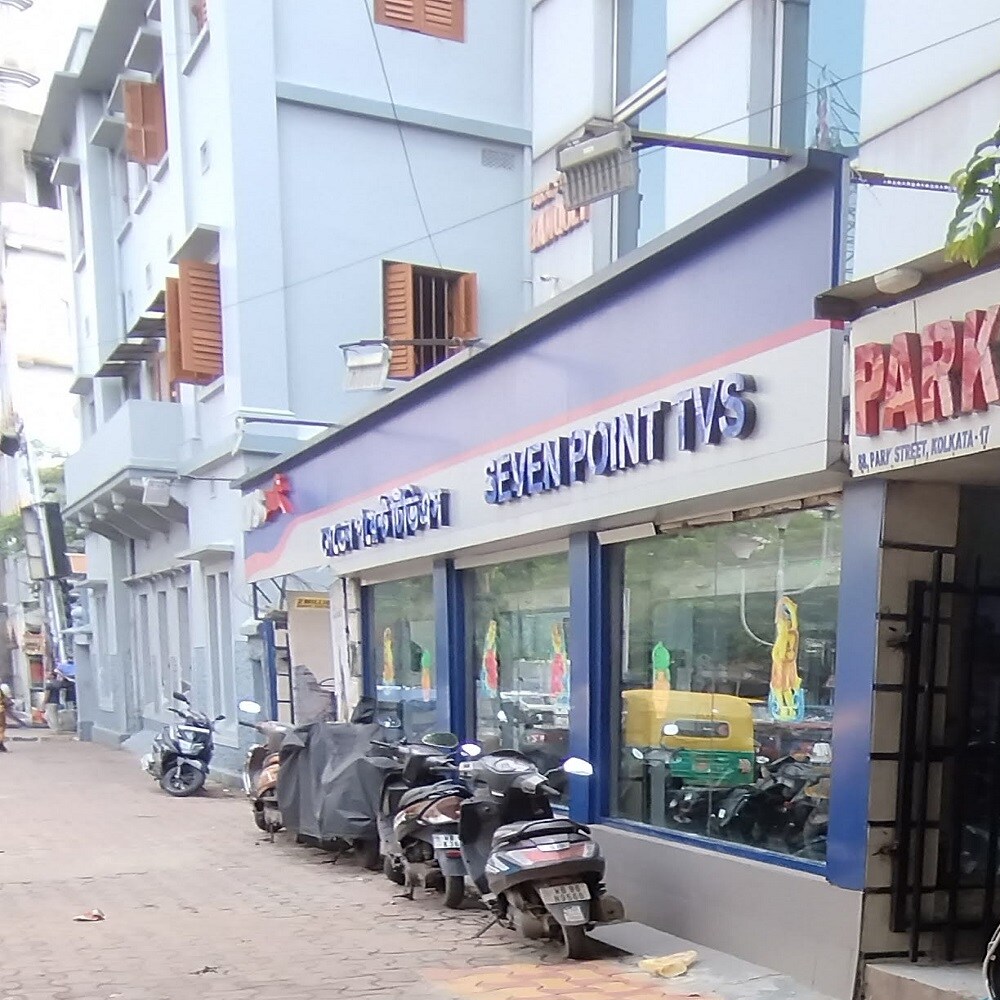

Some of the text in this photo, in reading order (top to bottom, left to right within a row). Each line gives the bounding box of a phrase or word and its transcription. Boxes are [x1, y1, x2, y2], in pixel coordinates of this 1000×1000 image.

[484, 372, 758, 504] SEVEN POINT TVS
